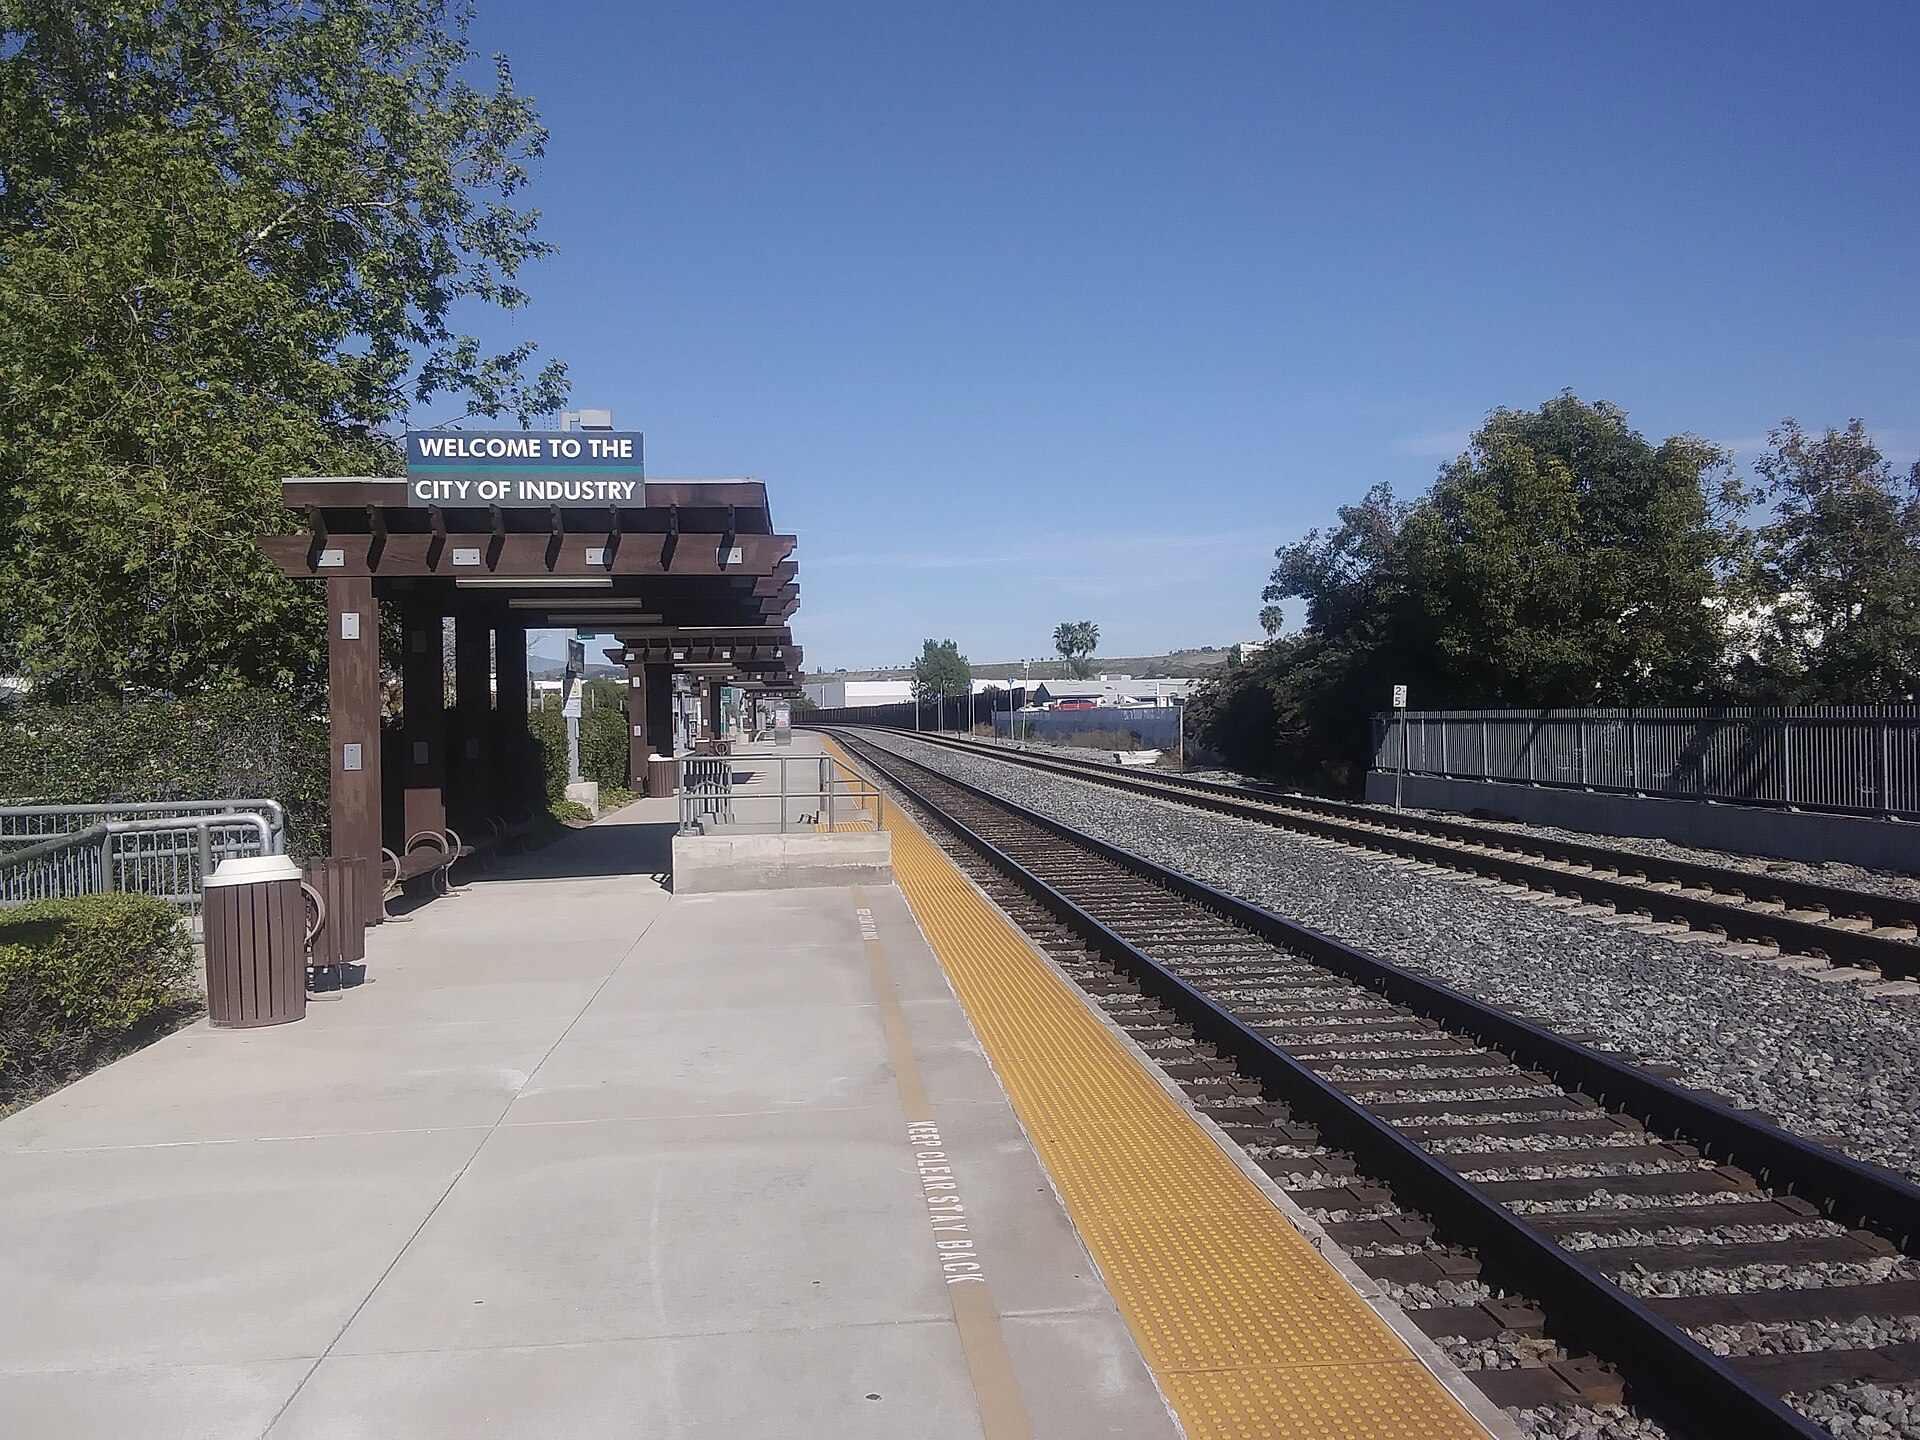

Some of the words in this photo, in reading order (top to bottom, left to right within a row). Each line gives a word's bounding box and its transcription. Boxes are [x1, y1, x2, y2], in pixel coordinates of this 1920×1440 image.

[418, 438, 542, 458] WELCOME
[548, 439, 581, 458] TO
[588, 439, 633, 458] THE
[415, 480, 472, 500] CITY
[478, 480, 511, 500] OF
[519, 481, 636, 501] INDUSTRY
[906, 1120, 942, 1146] KEEP
[915, 1151, 957, 1191] CLEAR
[927, 1195, 968, 1231] STAY
[935, 1239, 985, 1284] BACK
